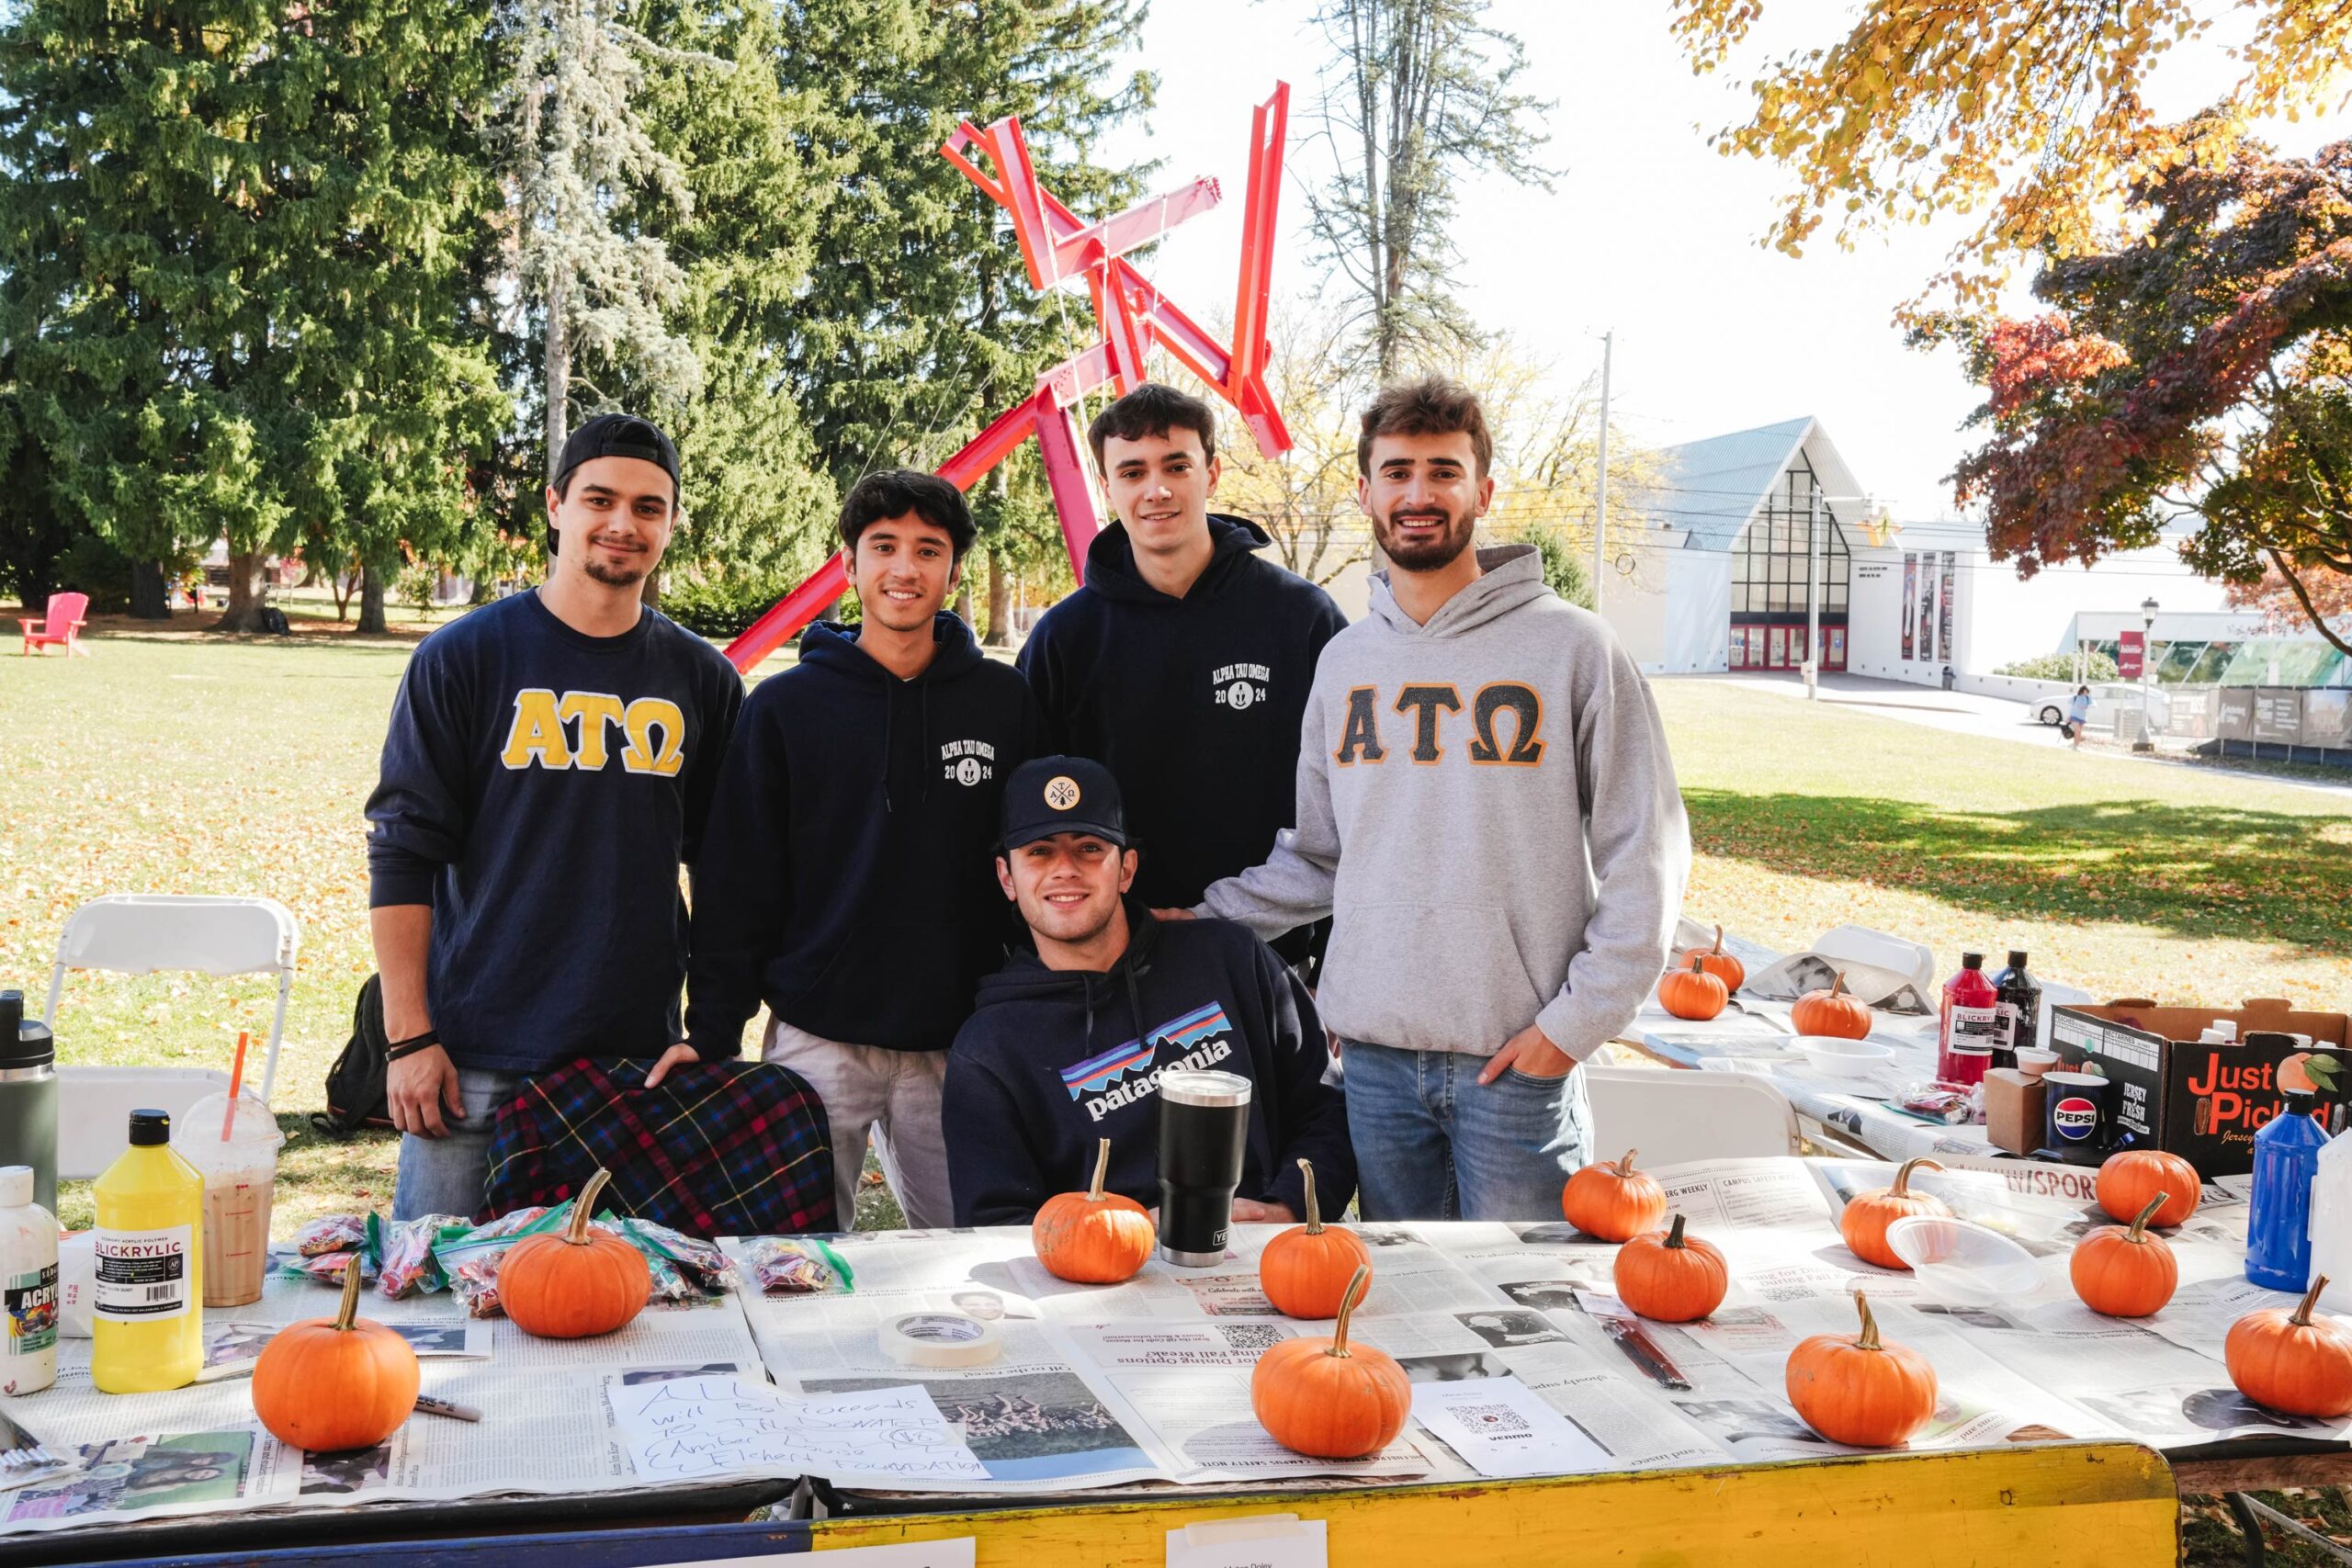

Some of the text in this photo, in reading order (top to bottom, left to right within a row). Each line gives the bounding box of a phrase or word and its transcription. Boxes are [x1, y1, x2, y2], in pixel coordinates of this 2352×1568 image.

[1213, 663, 1270, 685] ALPHA TAU OMEGA
[1215, 688, 1266, 704] 20 24
[941, 739, 994, 761] ALPHA TAU OMEGA
[944, 765, 992, 779] 20 24
[2055, 1012, 2075, 1026] PEACHES
[2105, 1030, 2136, 1044] NECTARINES
[2188, 1053, 2273, 1096] Just
[2123, 1082, 2147, 1102] JERSEY
[2056, 1112, 2095, 1123] PEPSI
[2121, 1100, 2146, 1122] FRESH
[2207, 1091, 2331, 1135] Picd
[1723, 1177, 1752, 1187] CAMPUS
[1679, 1183, 1709, 1195] WEEKLY
[1216, 1232, 1227, 1243] YE
[96, 1241, 182, 1258] BLICKRYLIC
[1117, 1358, 1178, 1367] Options
[1180, 1358, 1233, 1366] Dining
[1004, 1368, 1028, 1376] the
[1563, 1373, 1609, 1386] ghostly
[1488, 1432, 1532, 1441] venmo
[1670, 1448, 1696, 1459] and
[1230, 1460, 1267, 1468] SAFETY
[1274, 1458, 1311, 1467] CAMPUS
